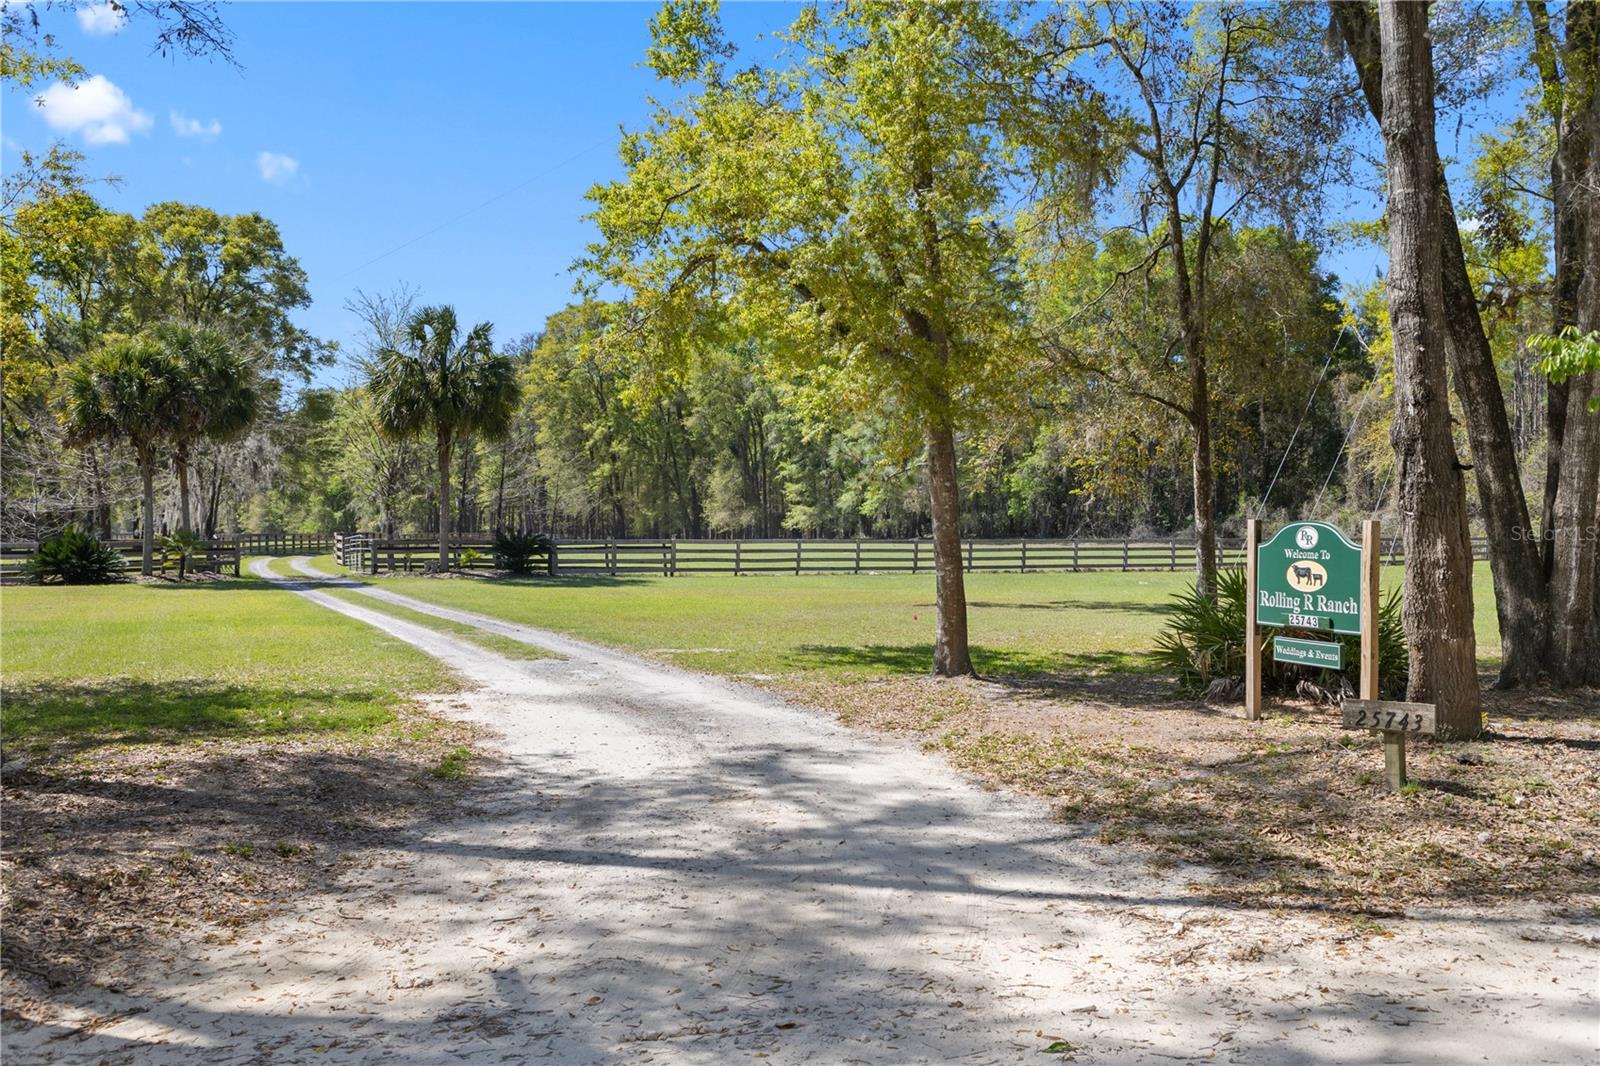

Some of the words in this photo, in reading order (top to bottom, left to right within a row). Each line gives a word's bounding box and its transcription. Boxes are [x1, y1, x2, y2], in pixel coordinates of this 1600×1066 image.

[1284, 548, 1318, 560] Welcome
[1319, 550, 1331, 560] To
[1259, 590, 1300, 614] Rolling
[1303, 593, 1314, 611] R
[1317, 595, 1358, 614] Ranch
[1289, 615, 1318, 627] 25743
[1275, 644, 1307, 659] Weddings
[1307, 649, 1314, 658] &
[1315, 650, 1339, 661] Events
[1355, 710, 1423, 732] 25743
